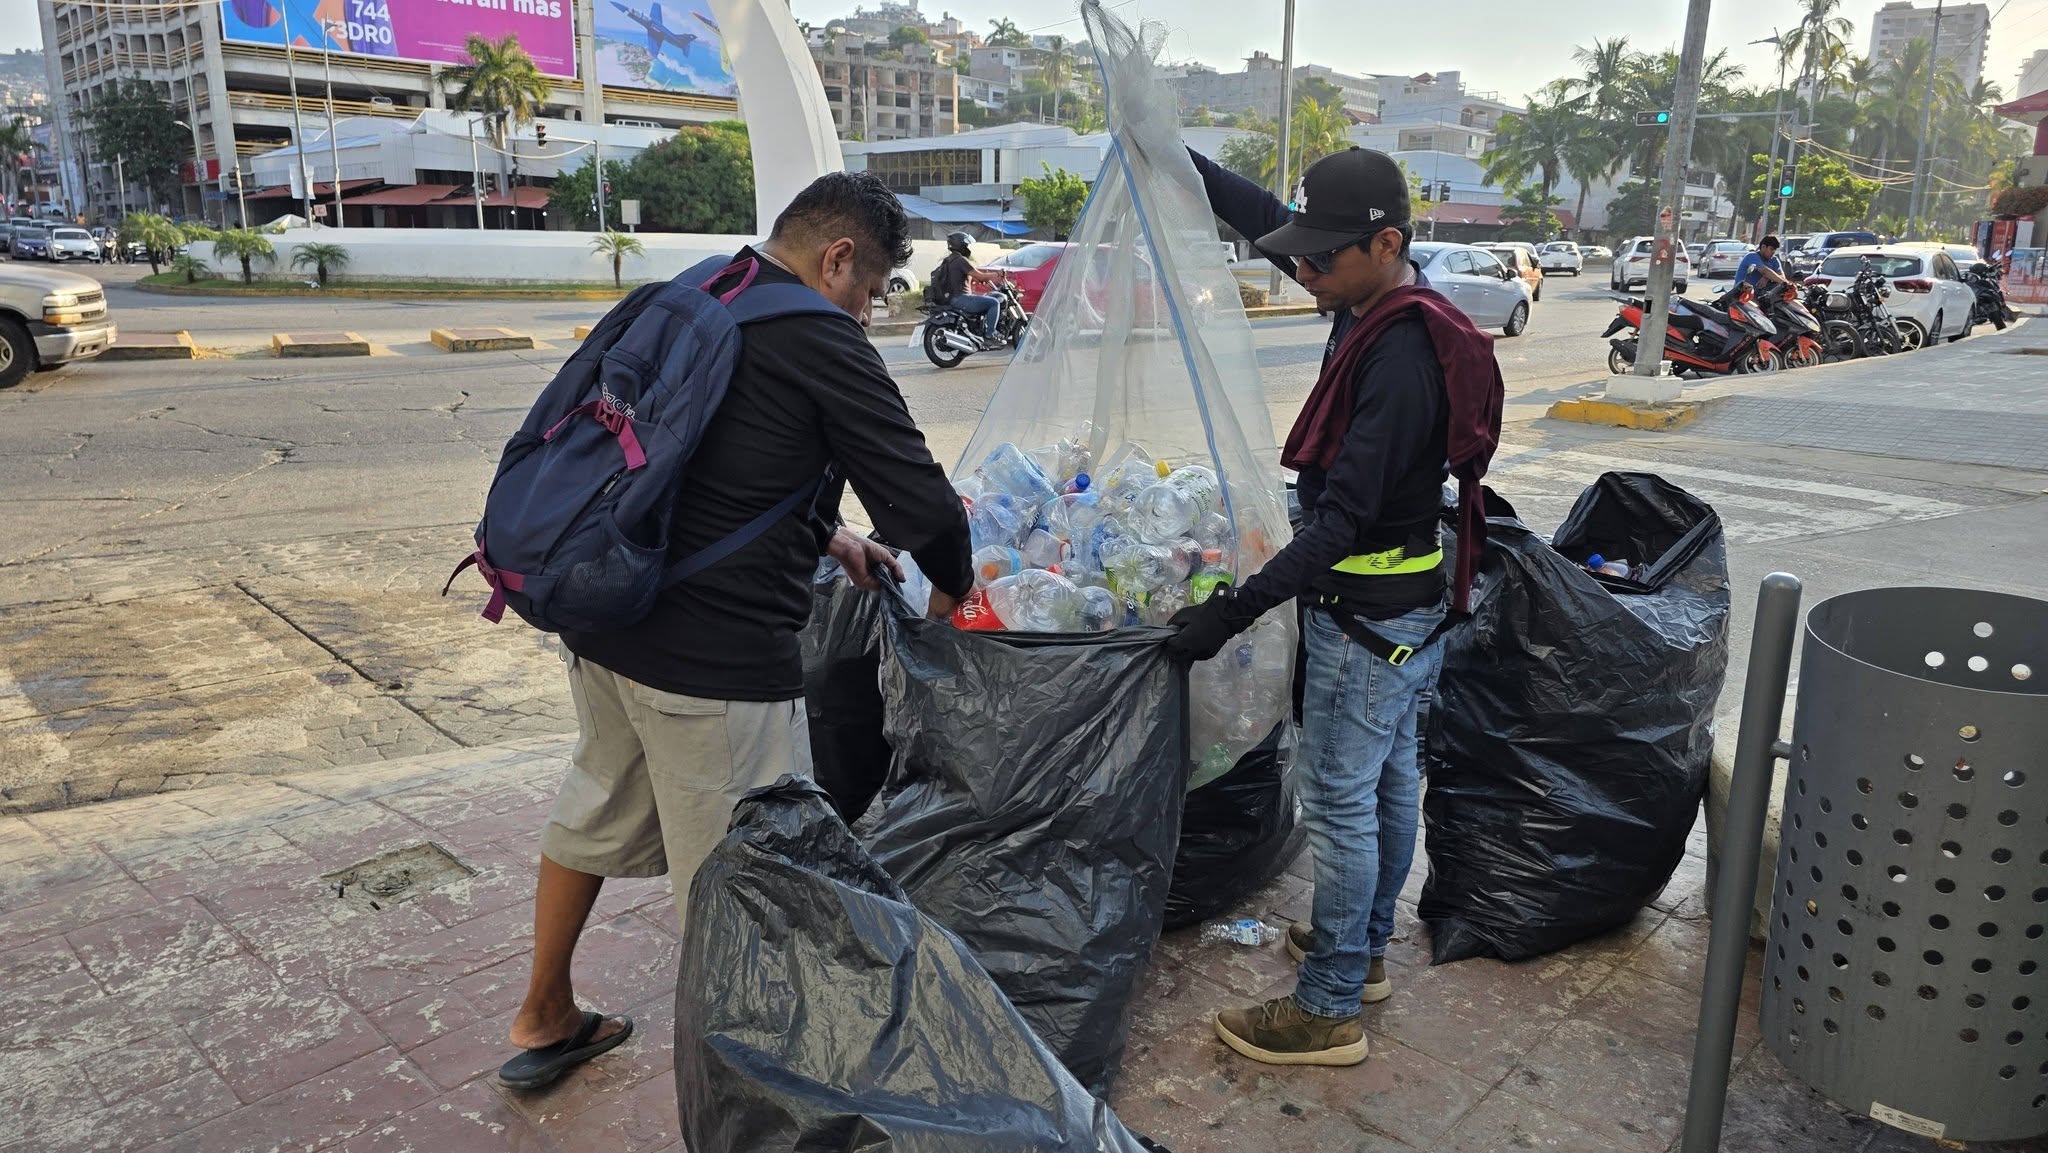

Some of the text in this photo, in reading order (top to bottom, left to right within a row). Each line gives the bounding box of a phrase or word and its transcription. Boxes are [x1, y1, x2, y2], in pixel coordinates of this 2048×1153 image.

[351, 0, 391, 21] 744
[1294, 176, 1308, 214] LA
[1194, 586, 1214, 598] fuz
